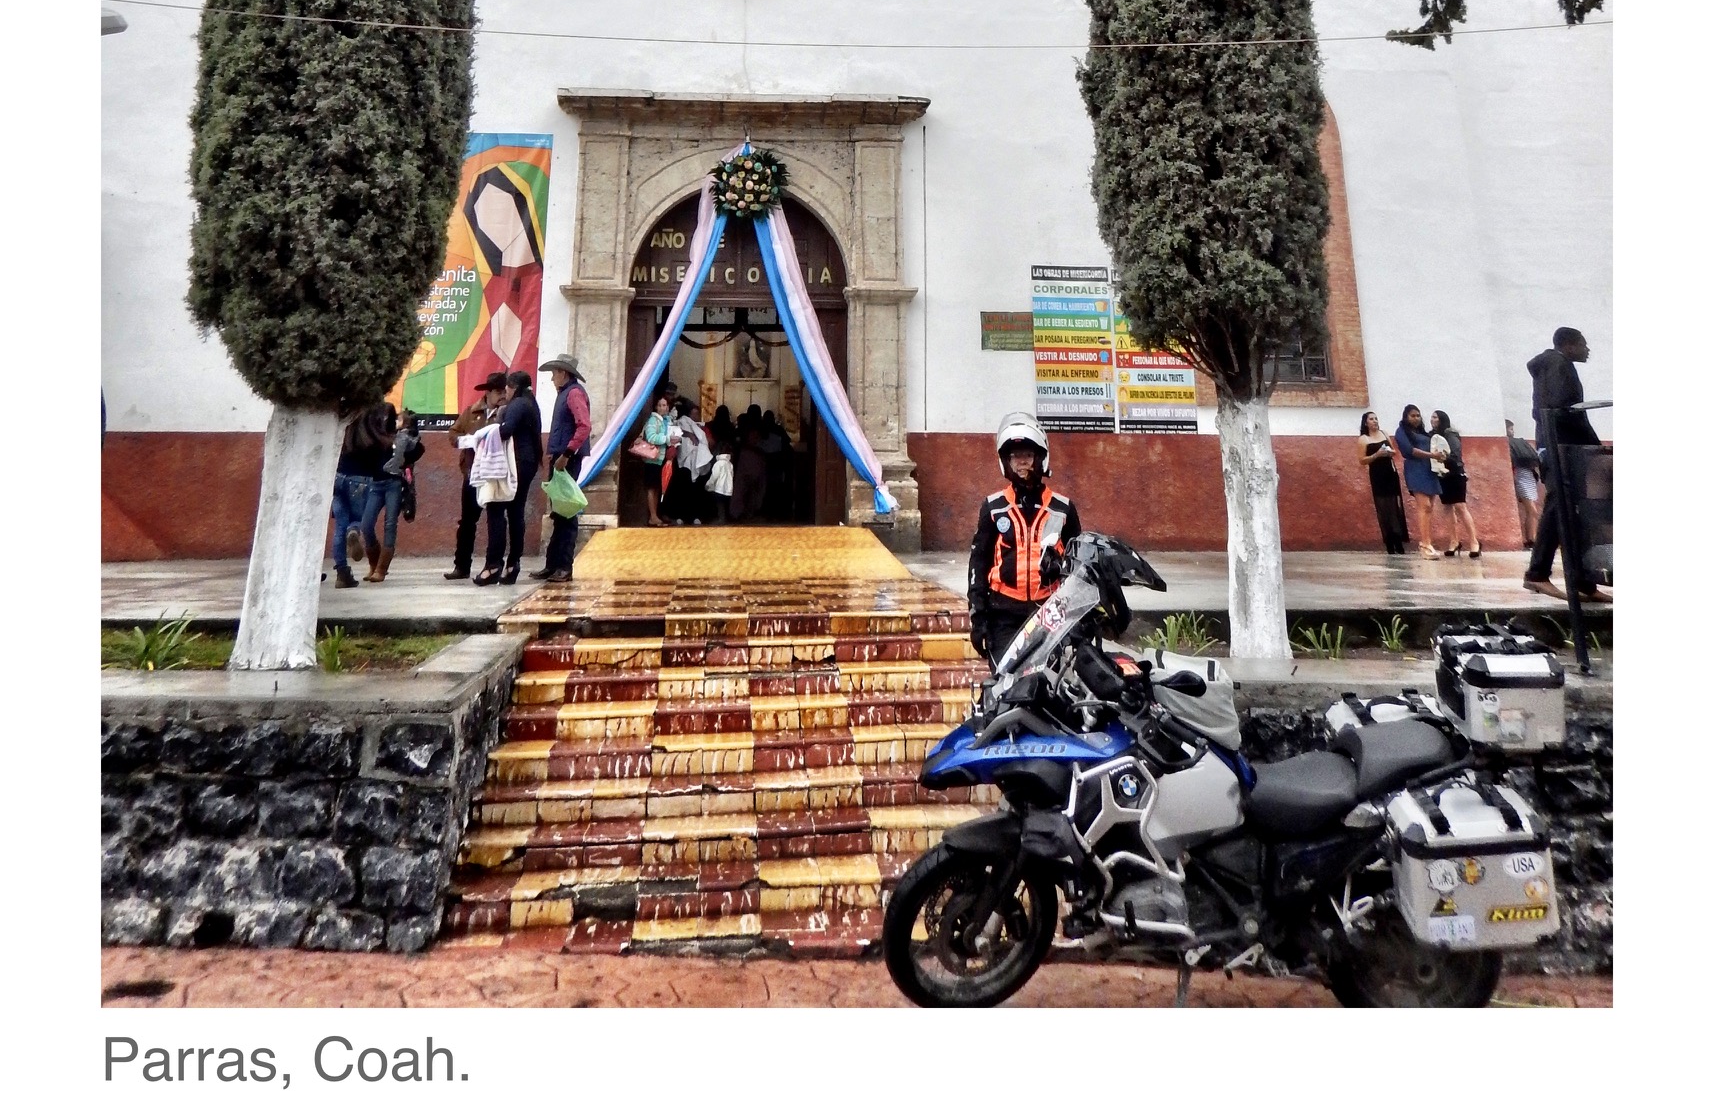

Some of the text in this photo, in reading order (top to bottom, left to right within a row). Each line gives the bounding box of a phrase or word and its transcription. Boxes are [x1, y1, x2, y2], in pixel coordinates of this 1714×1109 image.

[650, 228, 685, 249] AÑO
[436, 265, 476, 282] enita
[632, 266, 833, 284] MISEICOIA
[1032, 268, 1043, 278] LAS
[1044, 268, 1061, 279] OBRAS
[1062, 269, 1069, 279] DE
[428, 284, 470, 296] strame
[1033, 284, 1108, 295] CORPORALES
[424, 296, 467, 313] irada y
[418, 310, 458, 322] eve mi
[1067, 319, 1074, 327] AL
[1045, 335, 1063, 344] POSADA
[1064, 336, 1070, 344] AL
[1071, 336, 1098, 344] PEREGRINO
[1035, 352, 1098, 362] VESTIR AL DESNUDO
[1036, 369, 1099, 379] VISITAR AL ENFERMO
[1137, 373, 1184, 382] CONSOLAR AL TRISTE
[1037, 386, 1104, 396] VISITAR A LOS PRESOS
[436, 419, 456, 427] COMP
[1512, 857, 1536, 873] USA
